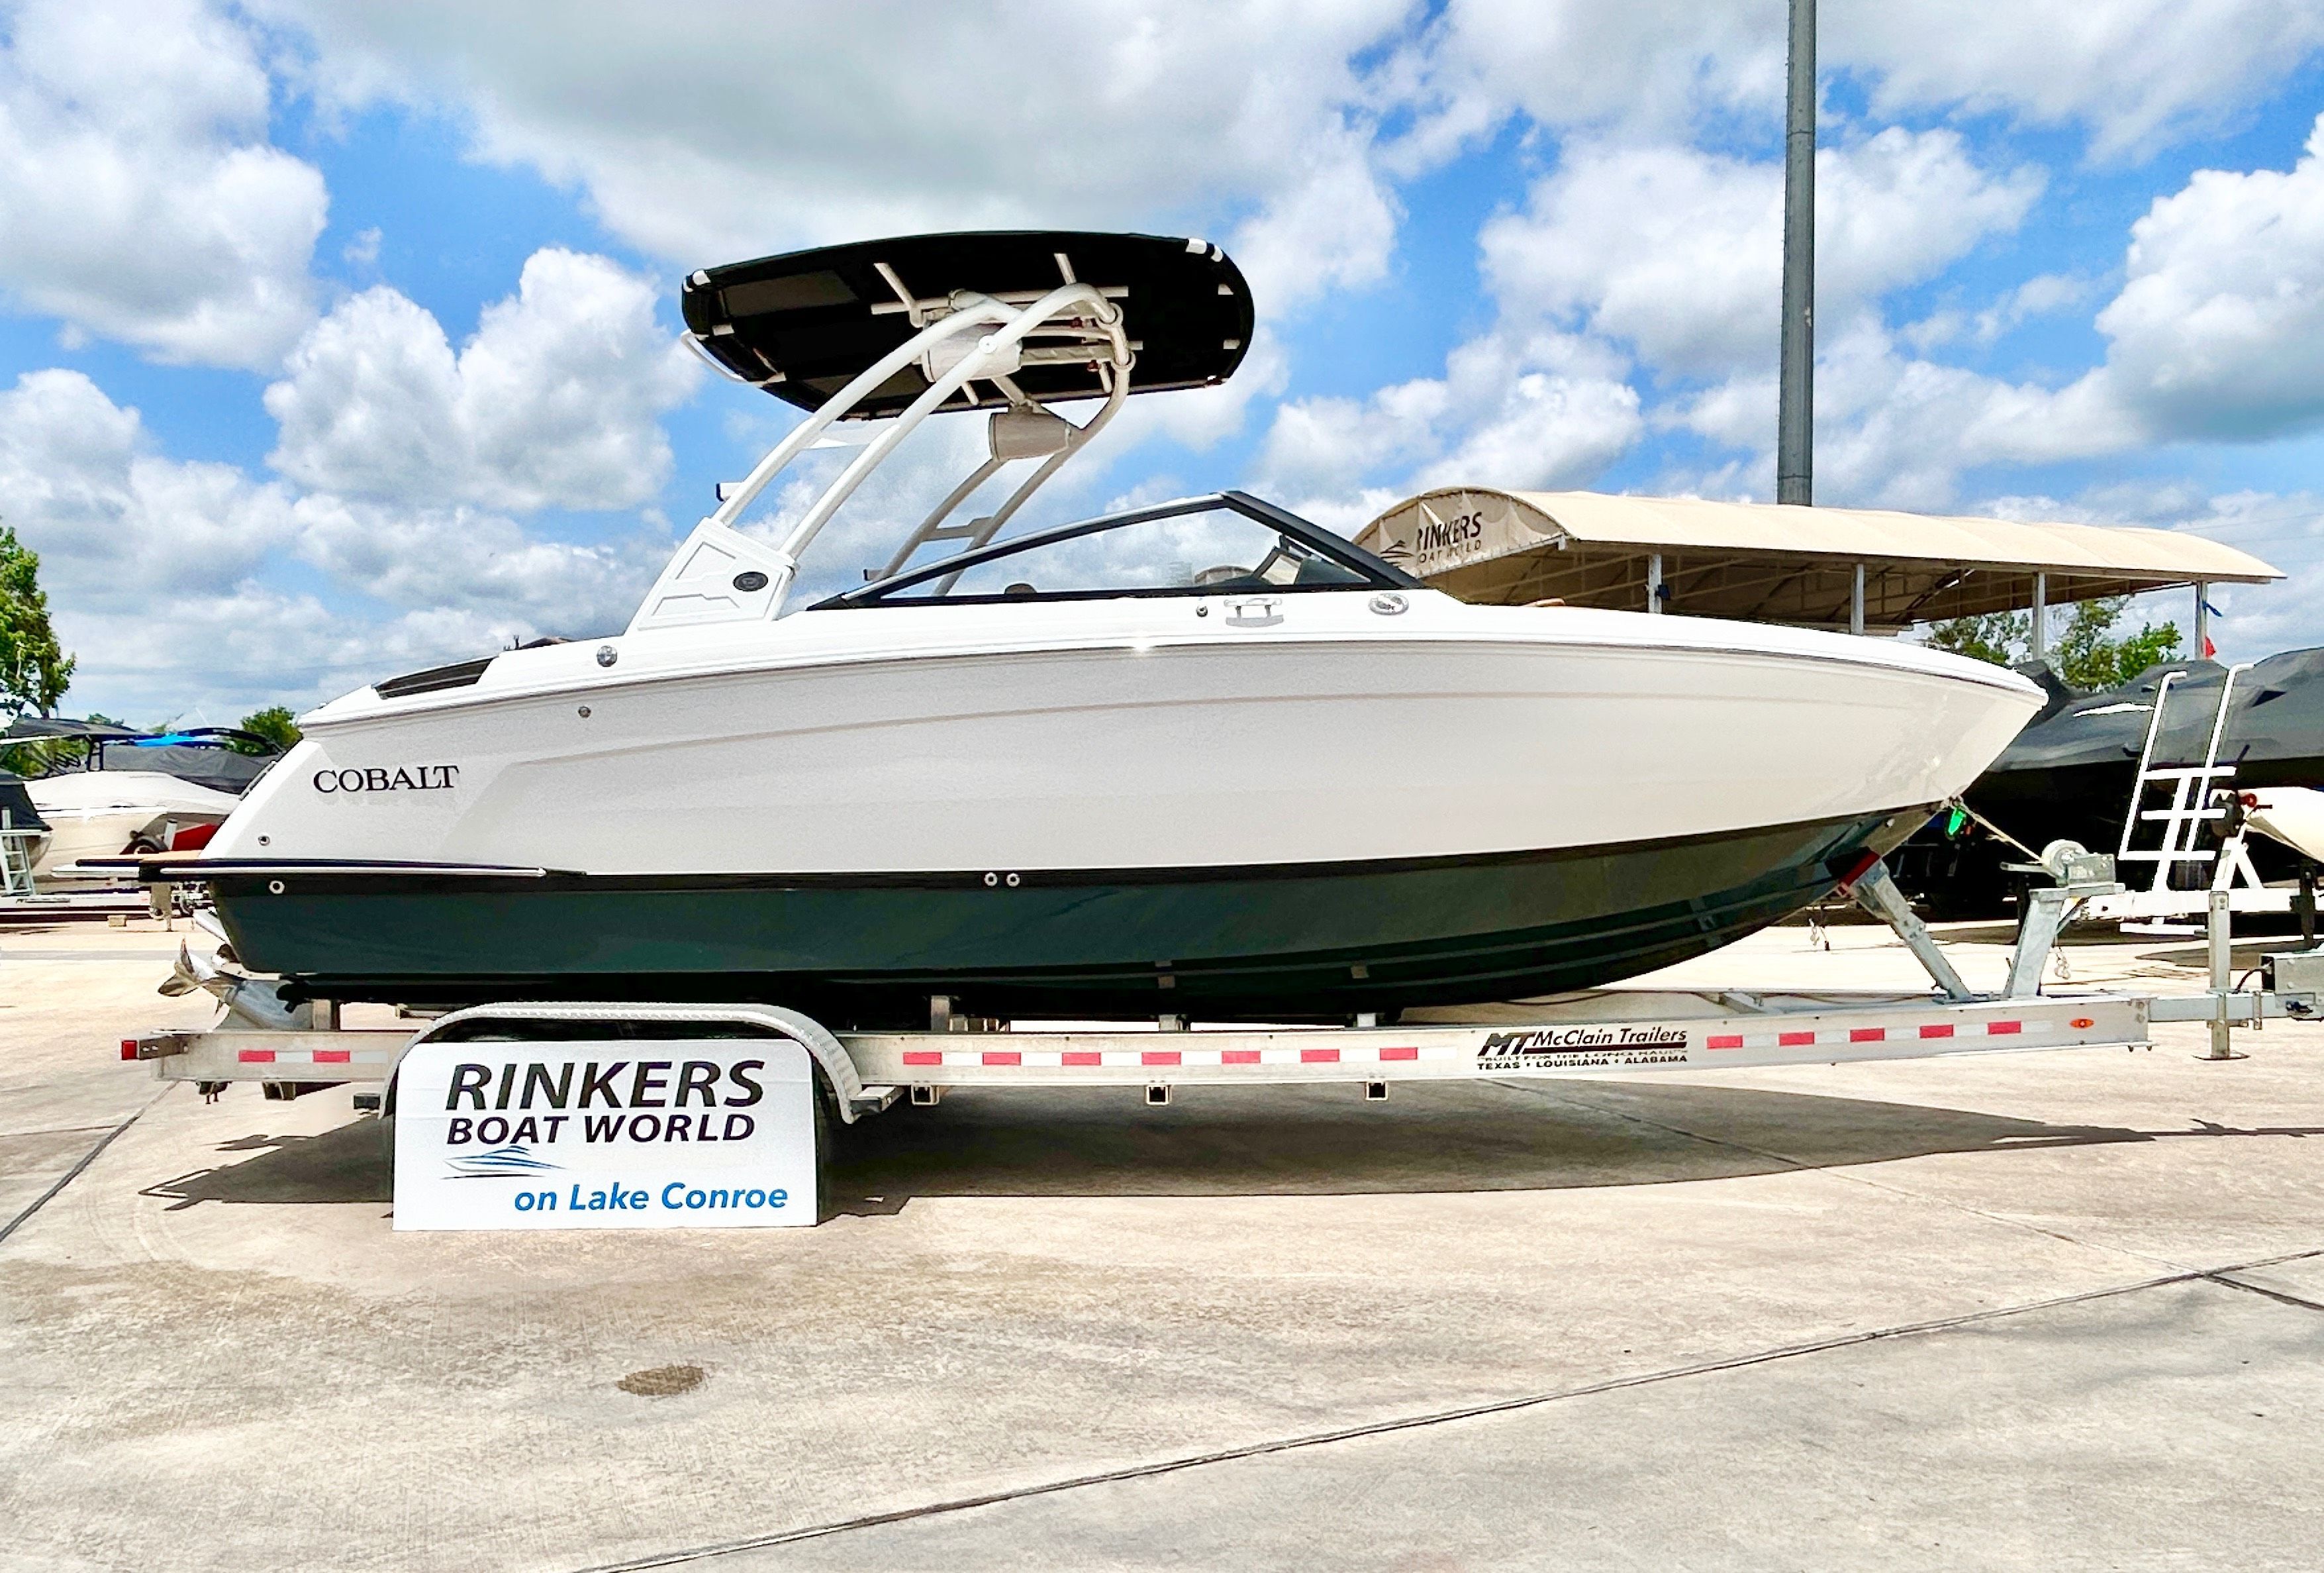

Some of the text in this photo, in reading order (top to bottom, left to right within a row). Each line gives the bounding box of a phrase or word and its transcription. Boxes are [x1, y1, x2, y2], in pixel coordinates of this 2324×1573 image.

[313, 765, 460, 793] COBALT
[1532, 1026, 1687, 1046] McClain Trailers
[1477, 1055, 1688, 1070] TEXAS LOUISIANA ALABAMA
[446, 1060, 765, 1111] RINKERS
[446, 1114, 755, 1144] BOAT WORLD
[514, 1182, 788, 1211] on Lake Conroe
